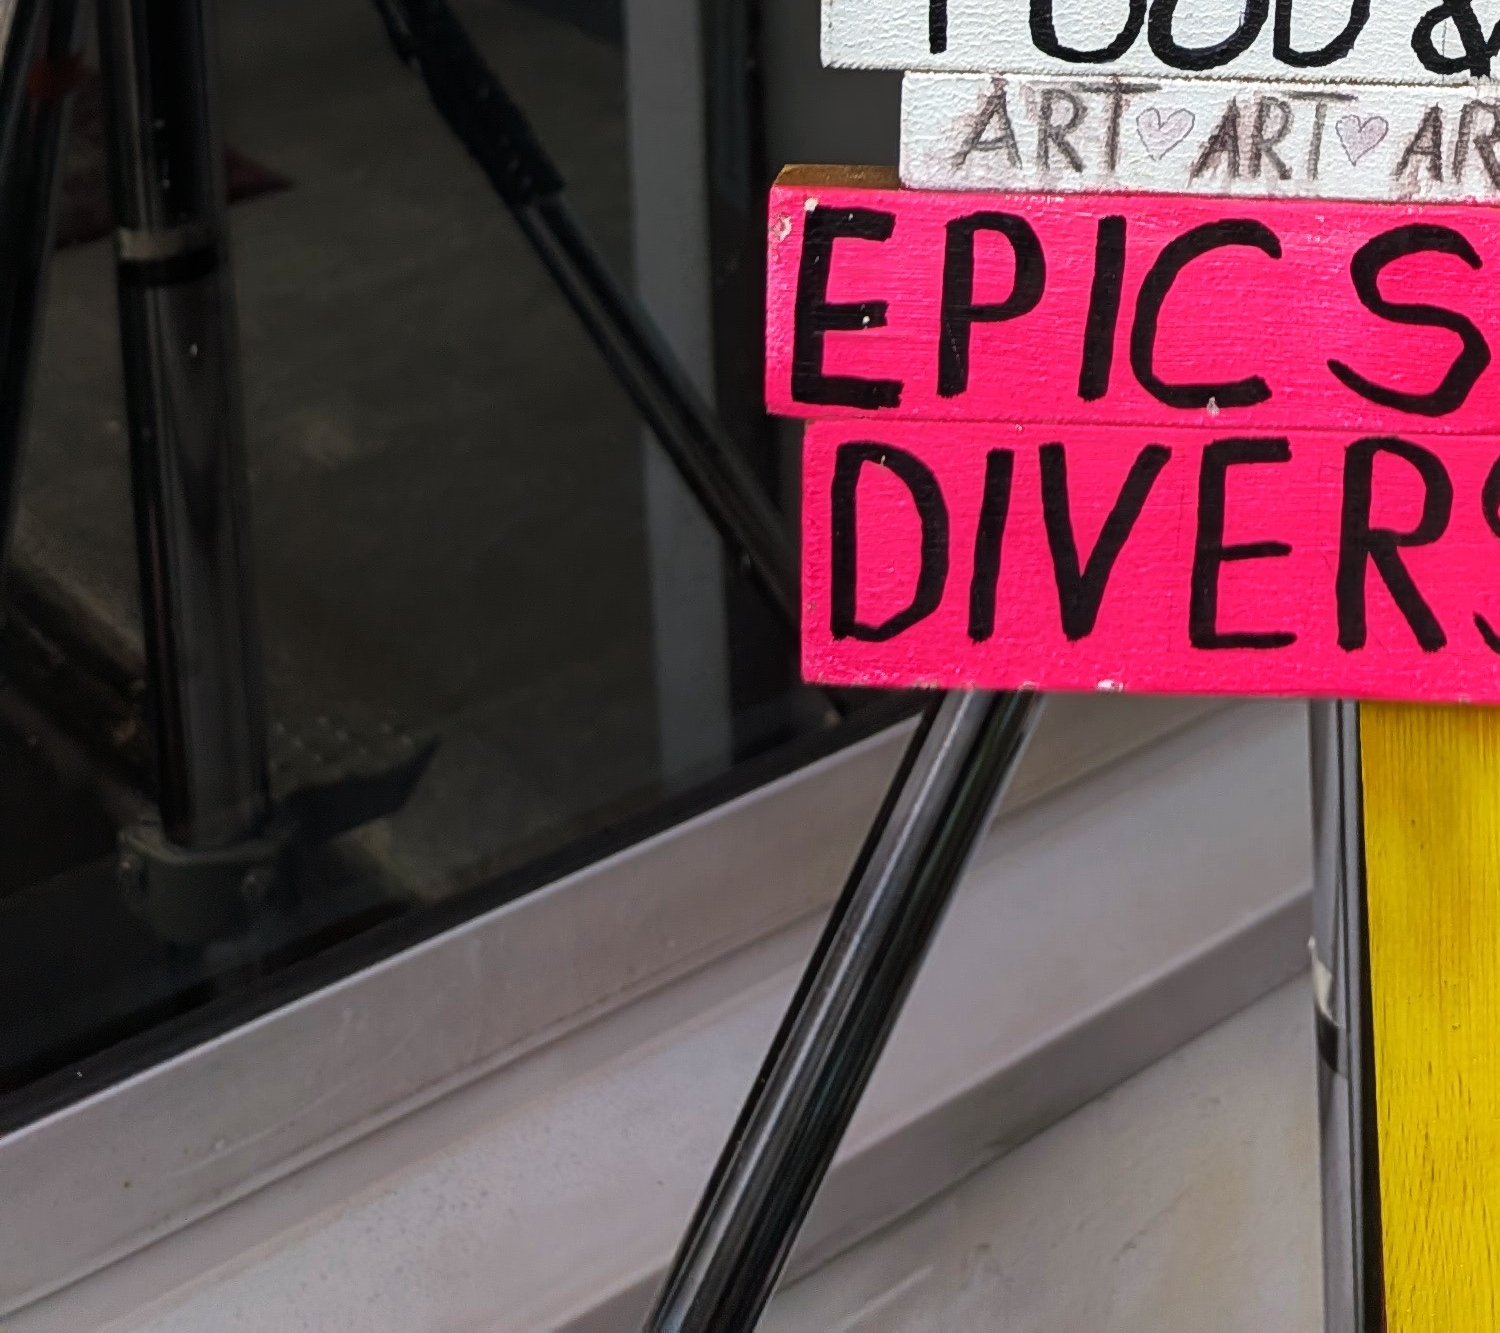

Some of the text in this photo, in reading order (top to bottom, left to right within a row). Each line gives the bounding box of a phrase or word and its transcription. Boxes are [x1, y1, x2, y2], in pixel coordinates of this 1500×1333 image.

[953, 75, 1160, 177] ART
[1190, 90, 1357, 182] ART
[792, 206, 1280, 409] EPIC
